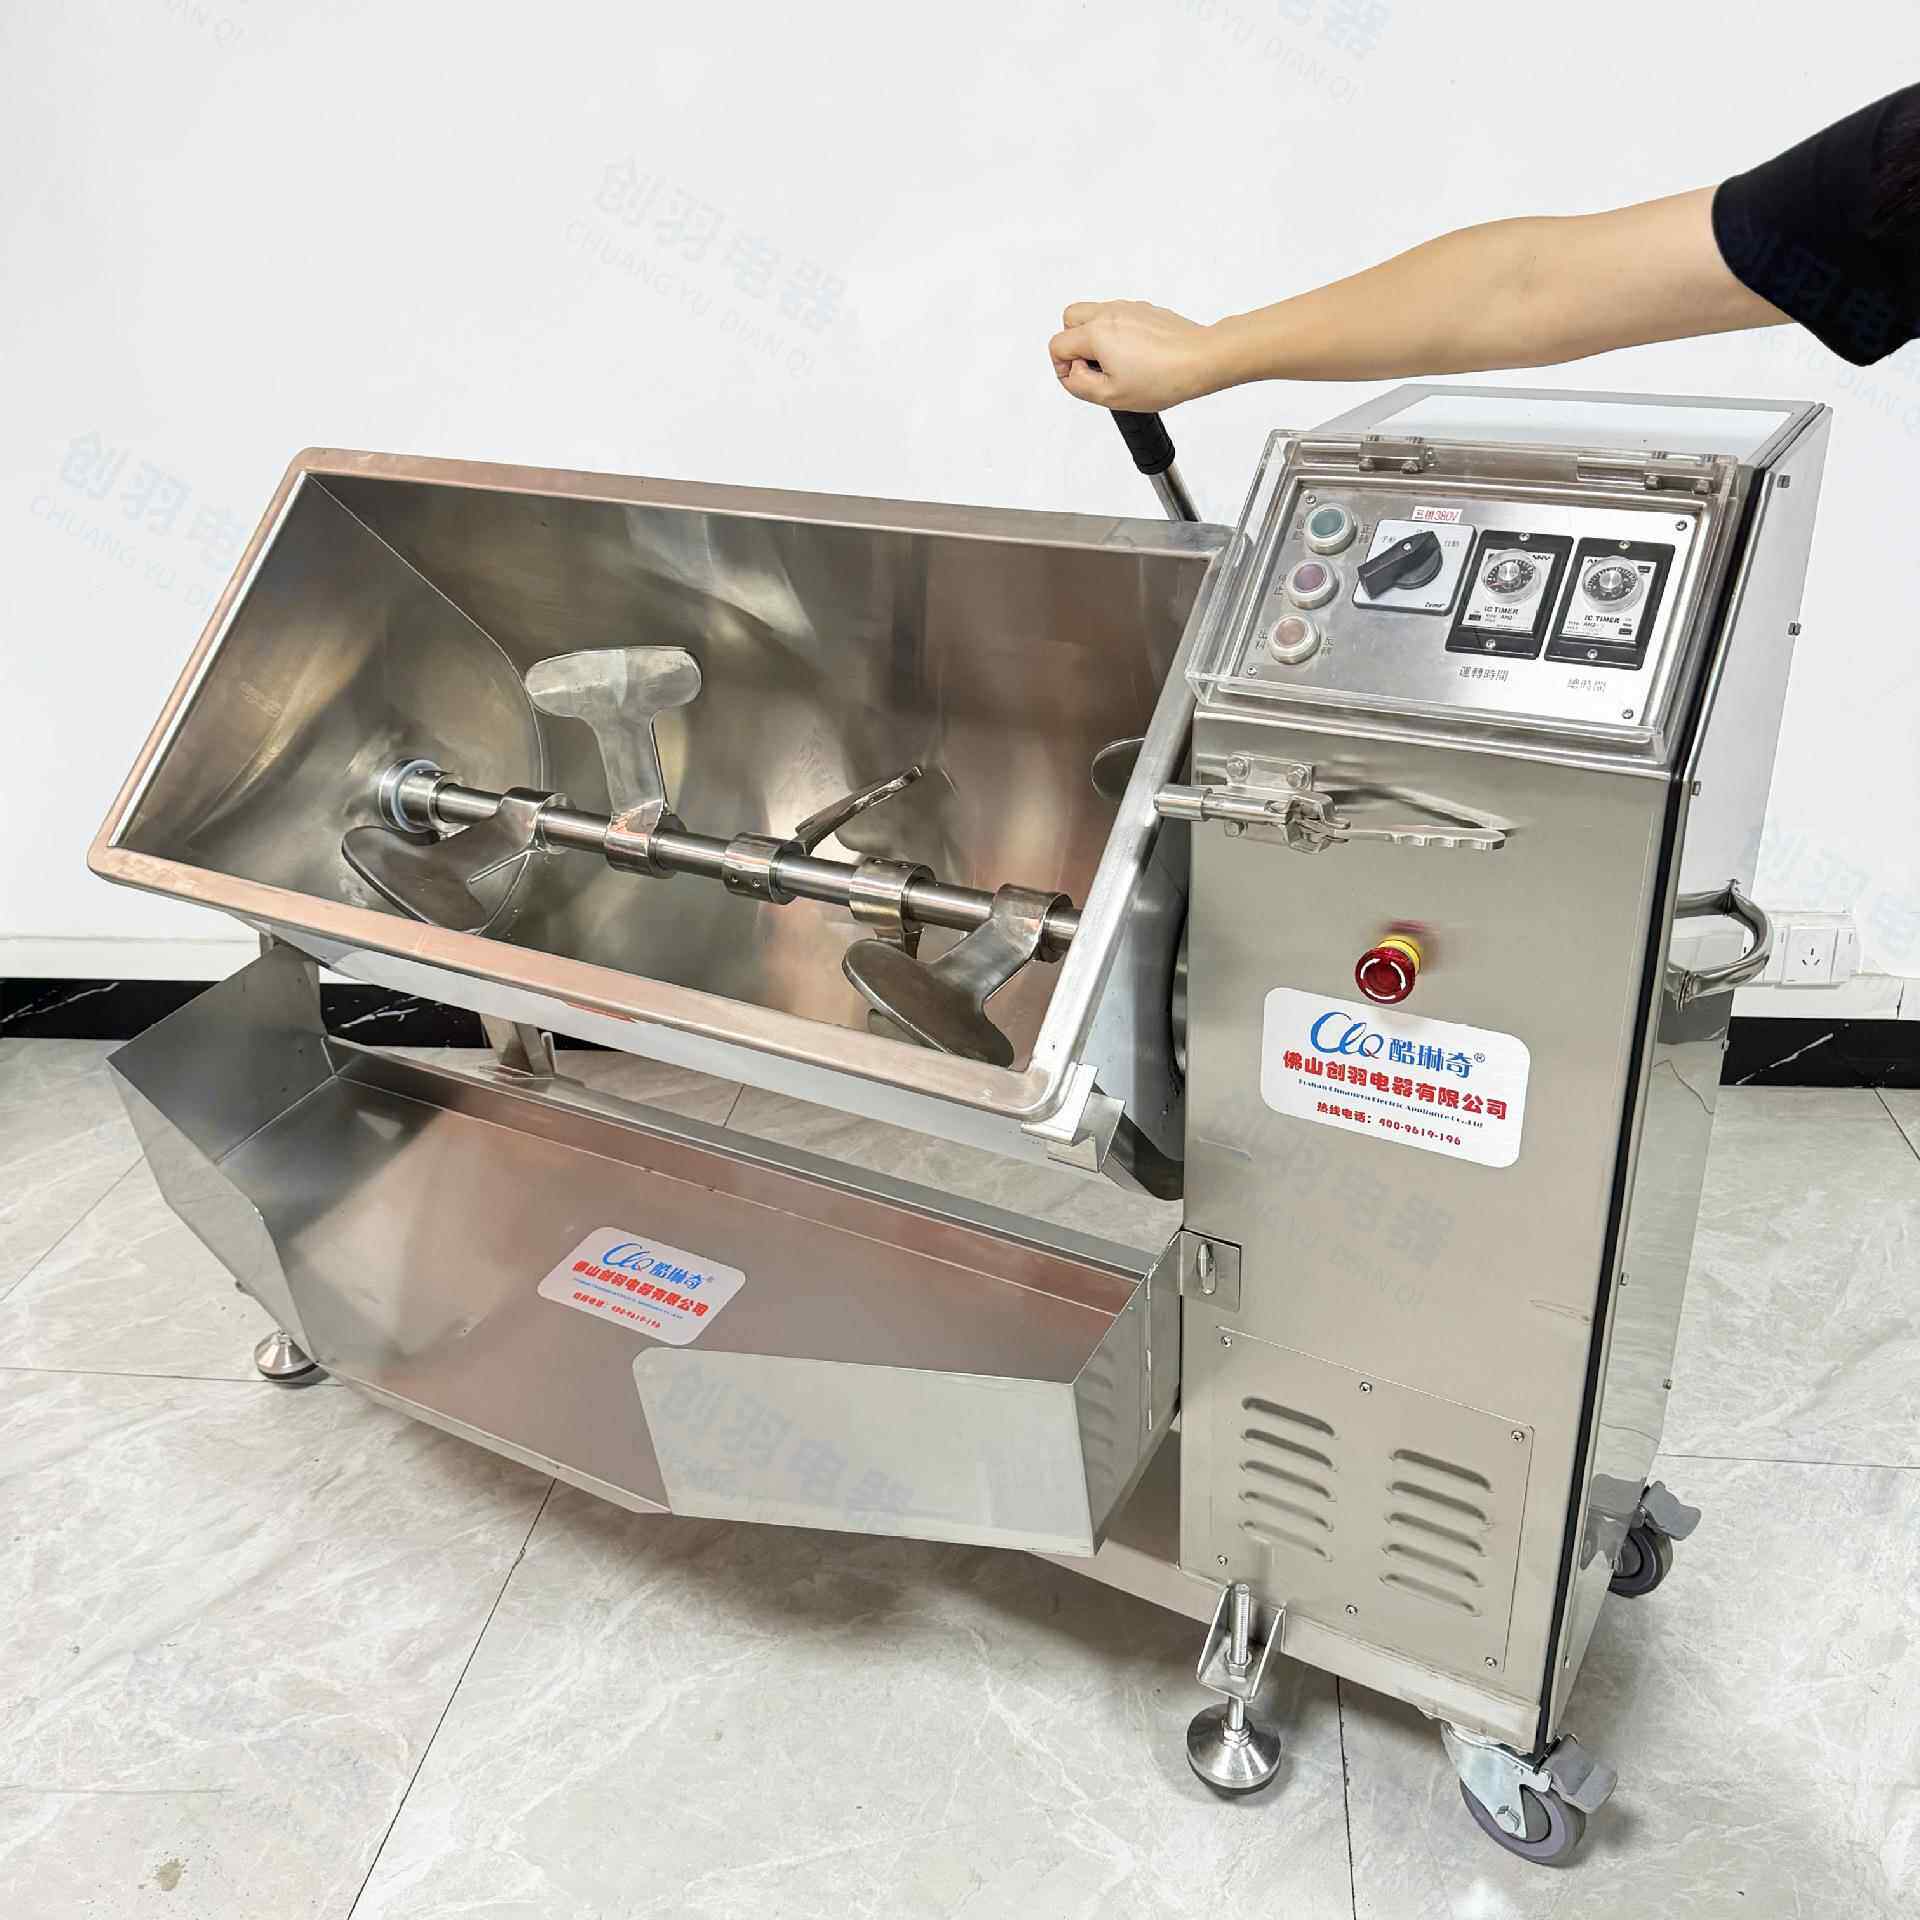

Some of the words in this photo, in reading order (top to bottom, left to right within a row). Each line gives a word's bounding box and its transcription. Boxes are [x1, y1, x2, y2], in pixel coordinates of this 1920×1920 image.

[1494, 606, 1519, 615] TIMER
[1595, 615, 1620, 624] TIMER
[1282, 1050, 1508, 1121] 佛山创羽电器有限公司
[1379, 1117, 1461, 1146] 400-9619-196
